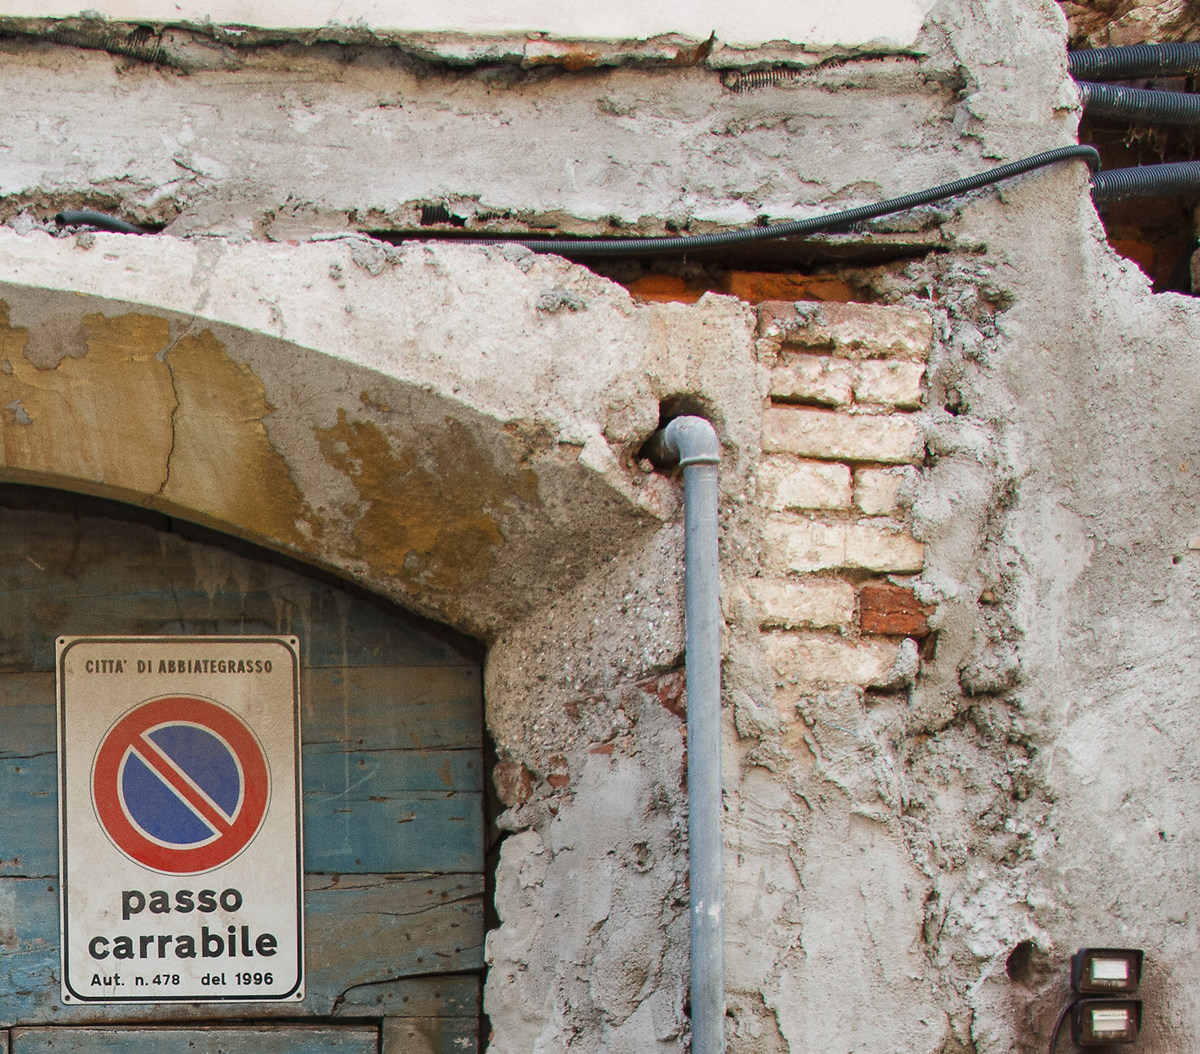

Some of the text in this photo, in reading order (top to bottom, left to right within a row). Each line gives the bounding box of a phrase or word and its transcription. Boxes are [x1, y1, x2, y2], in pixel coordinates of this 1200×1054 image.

[85, 659, 273, 674] CITTA' DI ABBIATEGRASSO
[121, 888, 243, 921] passo
[88, 925, 278, 960] carrabile
[90, 973, 125, 987] Aut.
[201, 972, 227, 986] del
[235, 972, 274, 986] 1996
